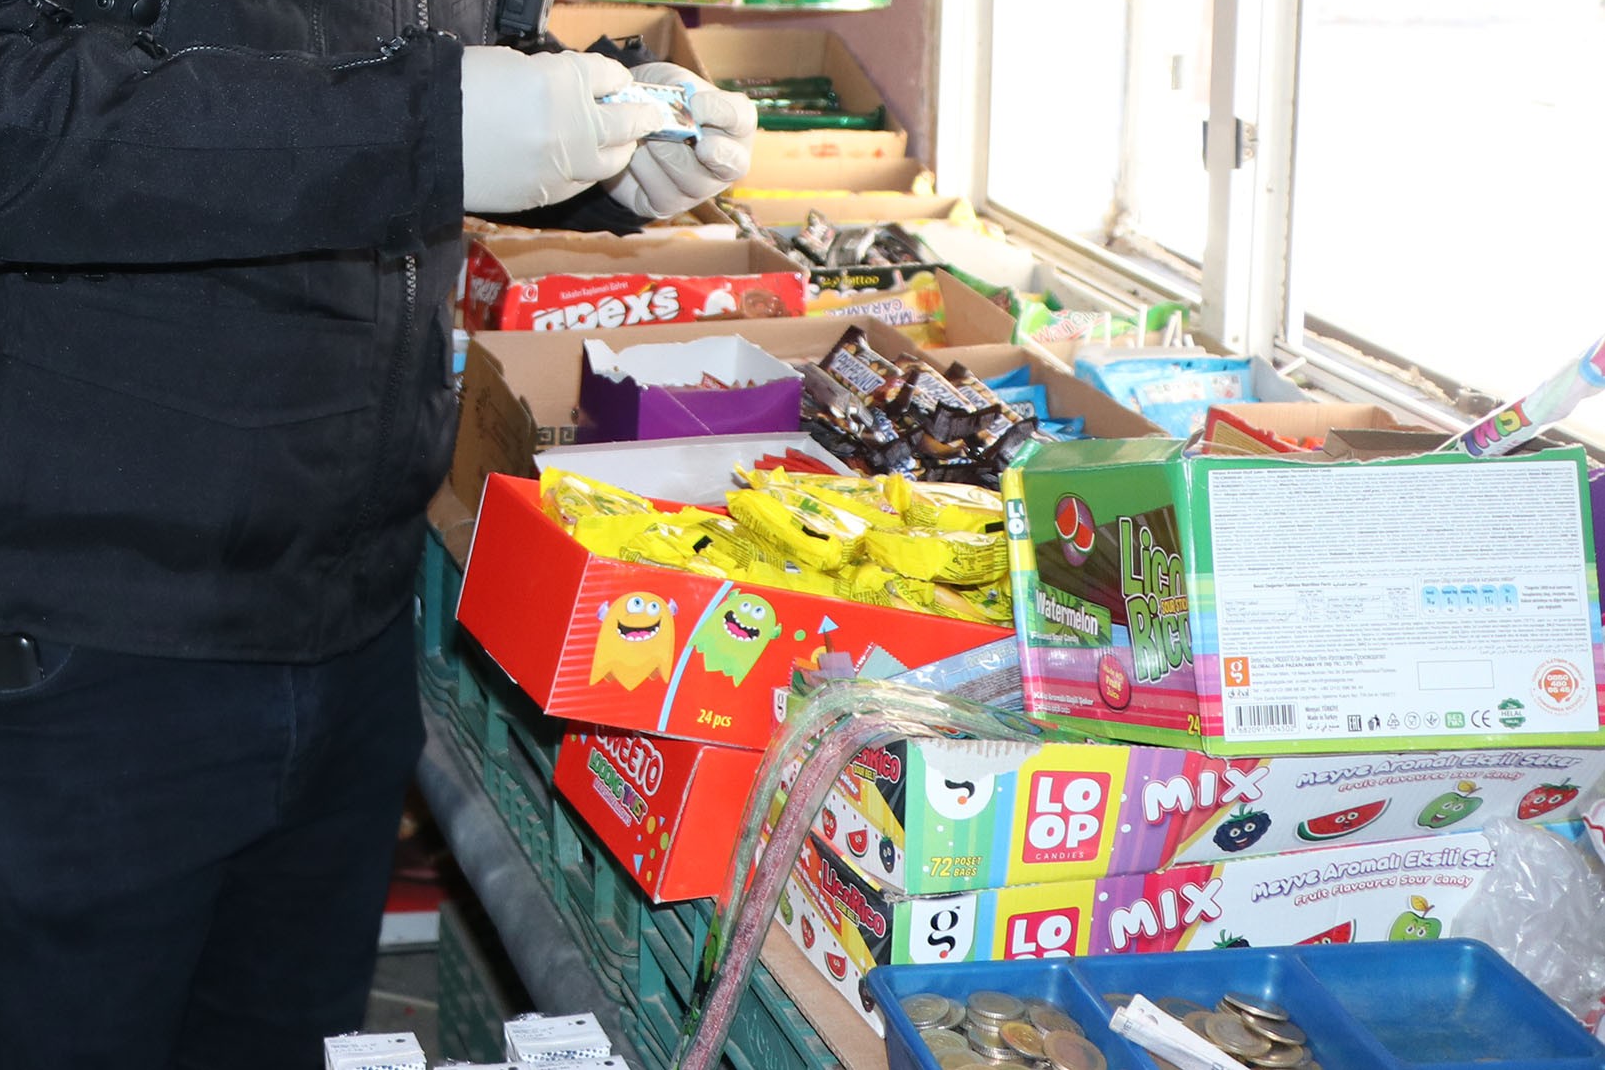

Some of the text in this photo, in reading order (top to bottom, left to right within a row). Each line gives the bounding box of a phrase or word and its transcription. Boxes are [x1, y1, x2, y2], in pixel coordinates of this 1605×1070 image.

[532, 286, 680, 331] apexs
[1462, 400, 1533, 457] TWIST
[1035, 589, 1099, 636] Watermelon
[696, 708, 732, 729] 24 pcs
[1187, 714, 1201, 736] 24
[595, 728, 664, 797] WEETO
[850, 746, 901, 784] coRico
[1295, 761, 1371, 789] Meyve
[1369, 754, 1459, 777] Aromalı
[1338, 776, 1378, 793] Fruit
[1379, 772, 1448, 788] Flavoured
[1483, 770, 1526, 783] Candy
[1035, 776, 1102, 814] LO
[1142, 765, 1271, 825] MIX
[1028, 814, 1101, 851] OP
[929, 857, 953, 878] 72
[953, 866, 979, 878] BAGS
[1035, 850, 1085, 861] CANDIES
[1250, 868, 1321, 903] Meyve
[1322, 852, 1402, 883] Aromalı
[1293, 874, 1475, 907] Fruit Flavoured Sour Candy
[1011, 914, 1073, 954] LO
[1109, 877, 1224, 954] MIX
